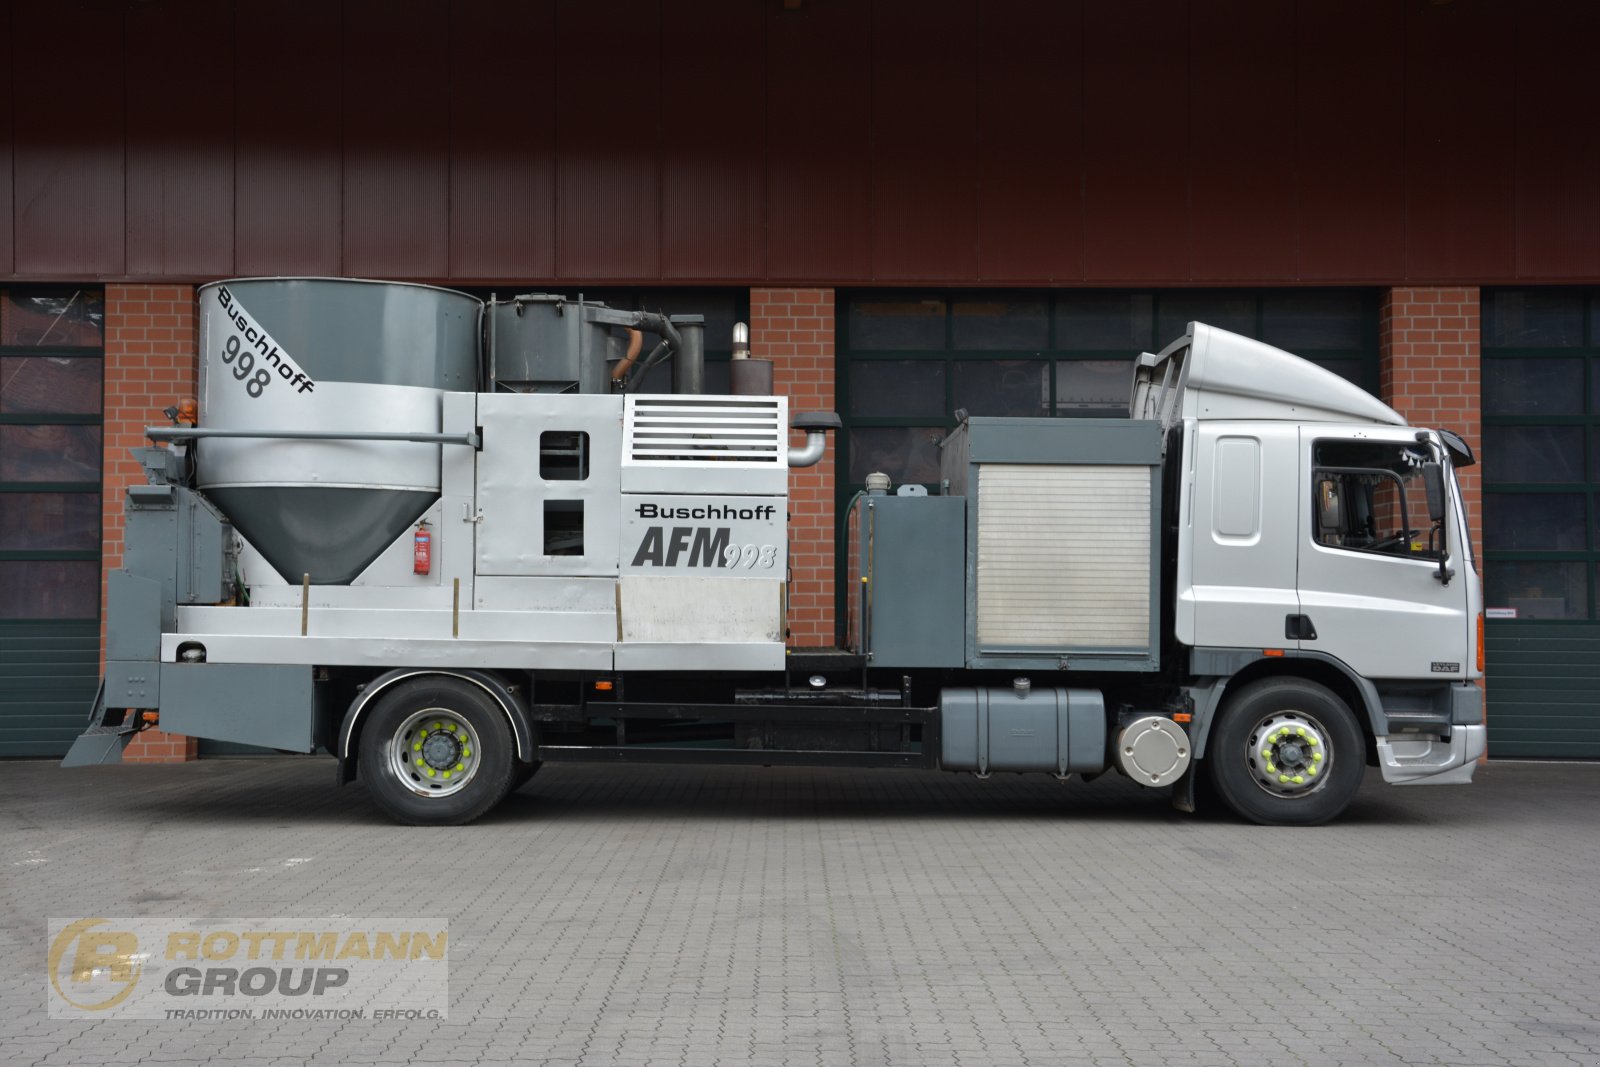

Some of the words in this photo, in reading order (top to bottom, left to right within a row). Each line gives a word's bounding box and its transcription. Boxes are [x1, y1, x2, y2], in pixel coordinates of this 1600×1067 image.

[217, 285, 315, 394] Buschhoff
[221, 335, 271, 398] 998
[634, 503, 776, 520] Buschhoff
[631, 526, 731, 568] AFM
[723, 543, 777, 569] 998
